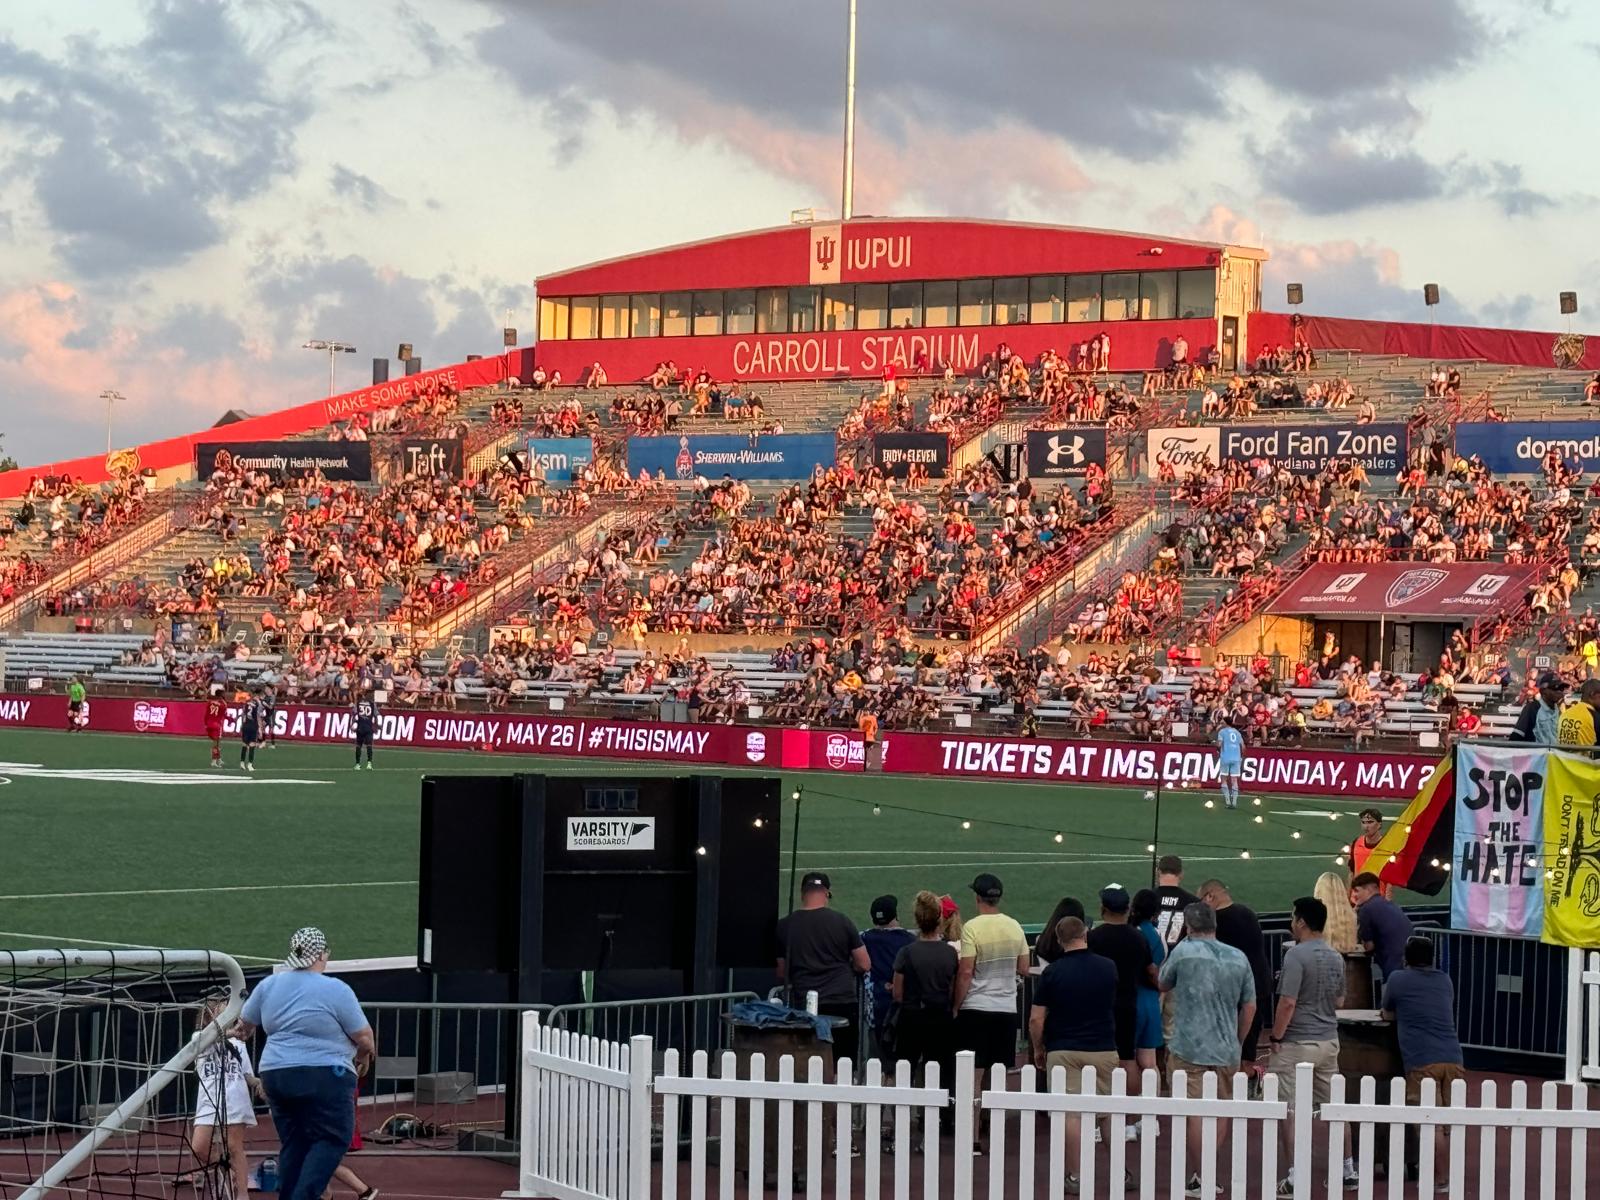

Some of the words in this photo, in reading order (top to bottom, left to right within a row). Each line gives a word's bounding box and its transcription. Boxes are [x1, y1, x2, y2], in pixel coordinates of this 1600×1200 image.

[847, 236, 911, 270] IUPUI
[733, 338, 849, 374] CARROLL
[861, 333, 979, 371] STADIUM
[327, 393, 368, 416] MAKE
[371, 382, 411, 404] SOME
[414, 370, 457, 393] NOISE
[1156, 436, 1212, 466] Ford
[1228, 430, 1279, 456] Ford
[1287, 431, 1329, 456] Fan
[1336, 430, 1398, 455] Zone
[233, 454, 287, 470] Community
[290, 457, 315, 468] Health
[315, 456, 349, 468] Network
[531, 446, 567, 470] ksm
[882, 448, 903, 463] INDY
[907, 448, 937, 463] ELEVEN
[0, 700, 31, 721] MAY
[359, 705, 372, 716] 30
[290, 711, 321, 737] AT
[323, 712, 416, 742] IMCOM
[424, 718, 501, 746] SUNDAY,
[506, 722, 549, 746] MAY
[550, 724, 575, 747] 26
[588, 728, 710, 755] #THISISMAY
[1561, 718, 1582, 730] CSC
[941, 740, 1053, 775] TICKETS
[1056, 746, 1098, 777] AT
[1101, 748, 1222, 783] IMS.COM
[1241, 756, 1348, 790] SUNDAY,
[1355, 762, 1415, 789] MAY
[1417, 764, 1436, 790] 2
[1462, 767, 1543, 816] STOP
[571, 821, 629, 837] VARSITY
[1488, 821, 1521, 842] THE
[573, 838, 626, 846] SCOREBOARDS
[1556, 832, 1569, 869] TRAD
[1460, 841, 1537, 886] HATE
[1552, 870, 1565, 889] ON
[1550, 889, 1561, 908] ME
